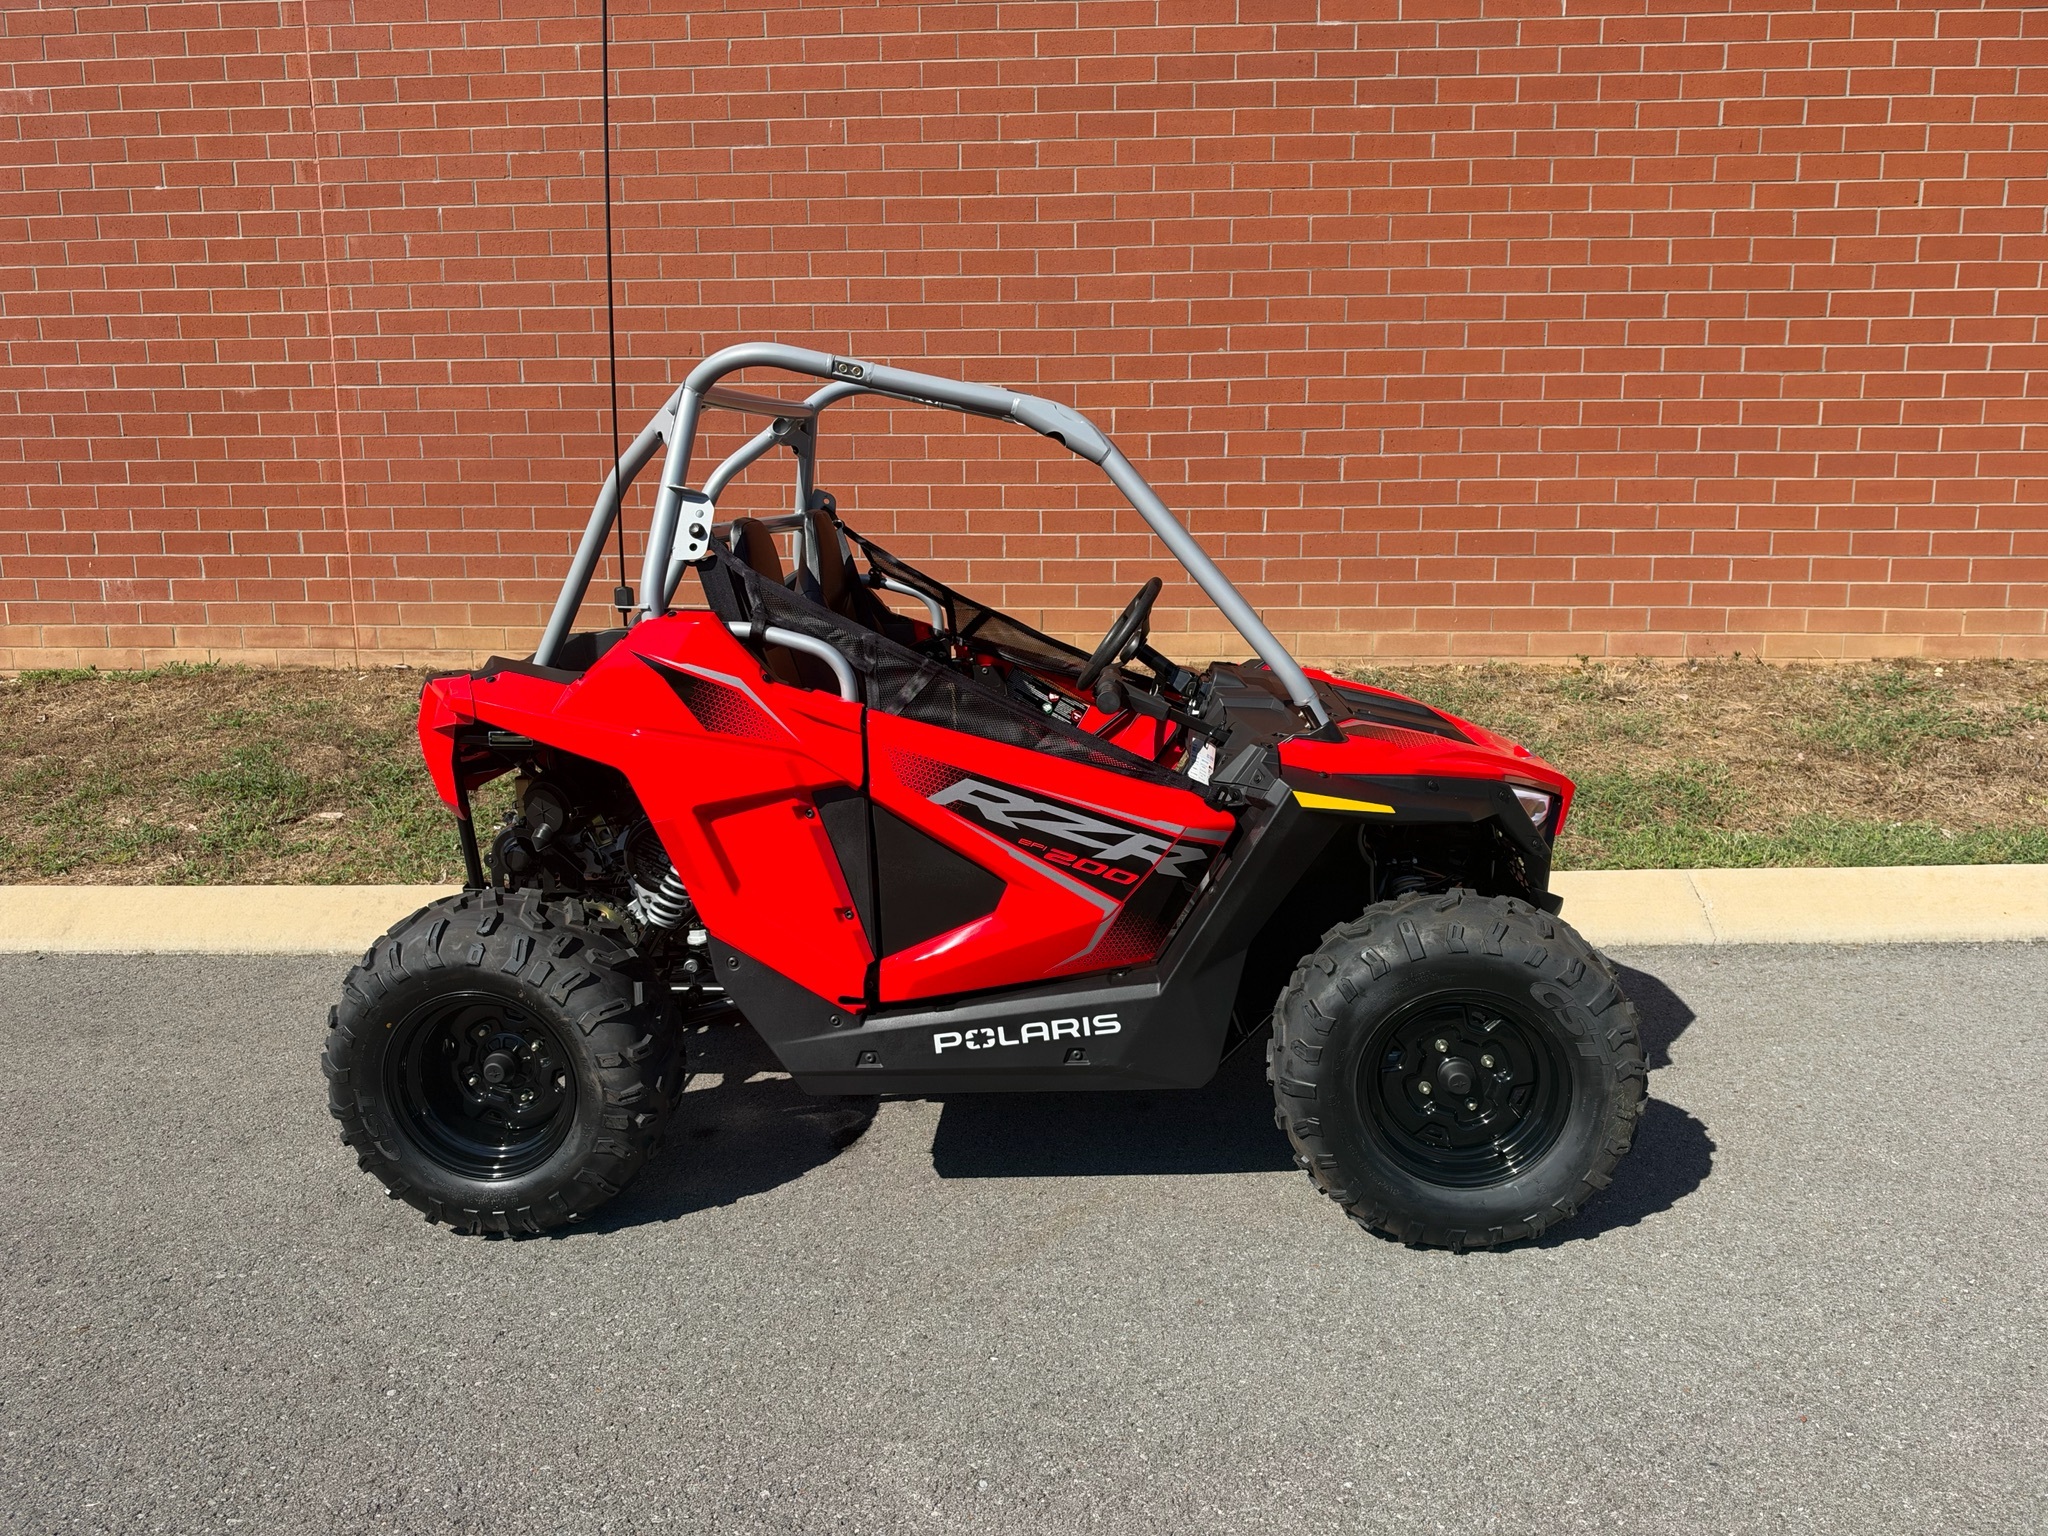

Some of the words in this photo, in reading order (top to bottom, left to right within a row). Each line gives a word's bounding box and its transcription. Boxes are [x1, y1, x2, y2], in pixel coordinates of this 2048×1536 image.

[926, 778, 1207, 878] RZR
[1018, 837, 1048, 852] EFI
[1043, 848, 1140, 885] 200
[933, 1013, 1122, 1054] POLARIS
[1529, 982, 1611, 1066] CST
[353, 1088, 402, 1162] CST
